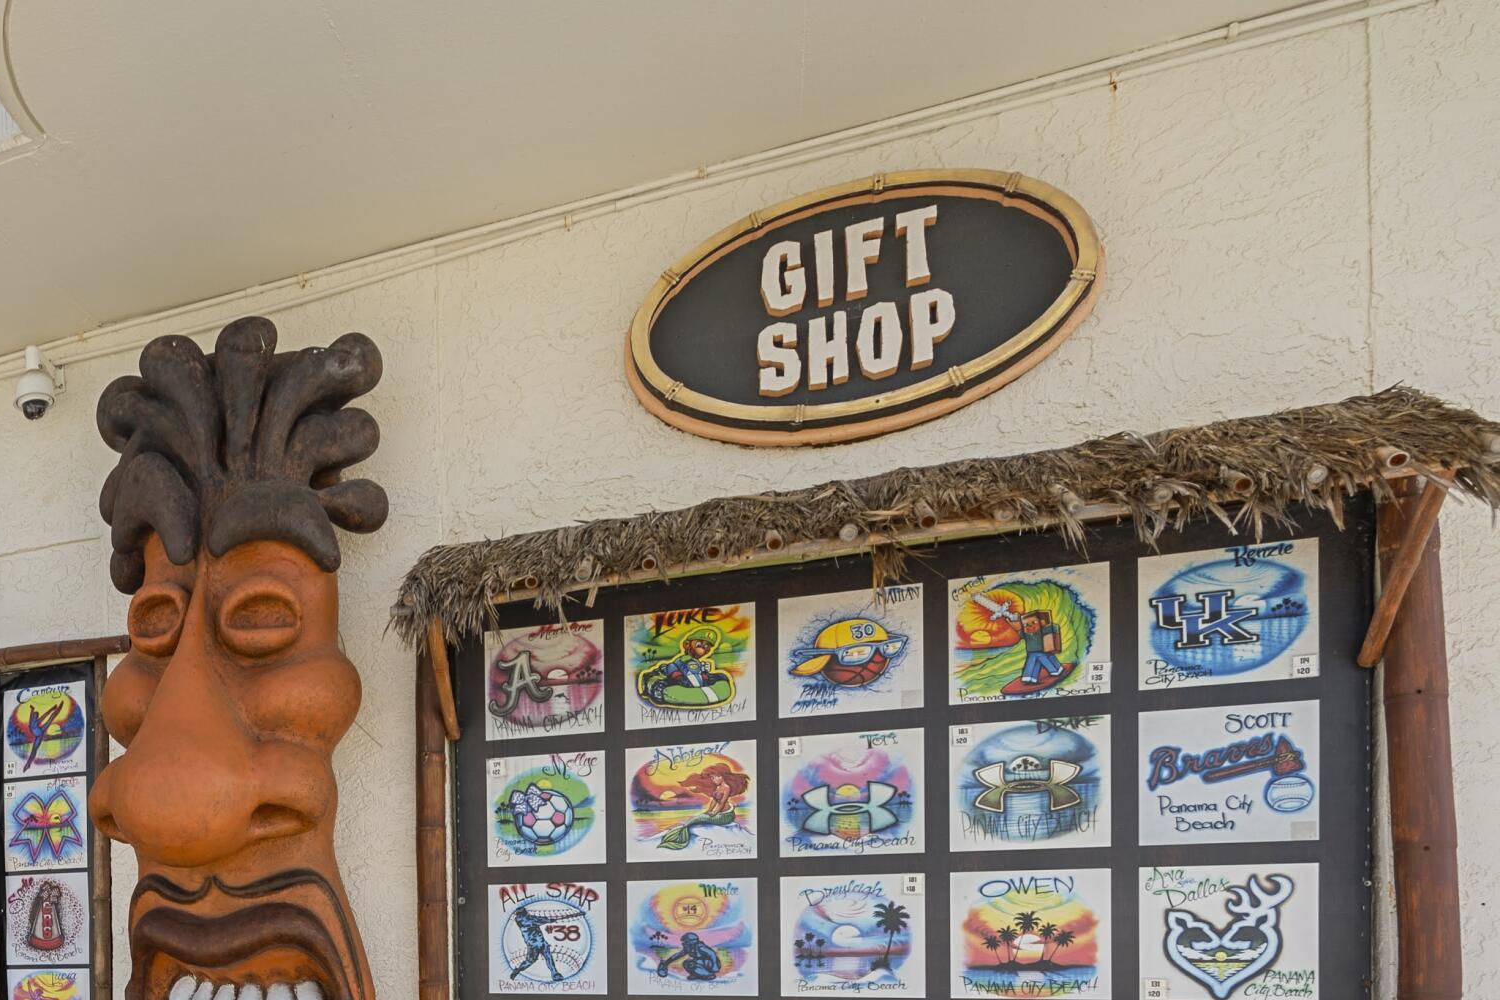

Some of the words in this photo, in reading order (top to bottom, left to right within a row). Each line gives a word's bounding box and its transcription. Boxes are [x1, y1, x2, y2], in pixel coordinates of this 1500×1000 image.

[760, 205, 938, 317] GIFT
[756, 288, 956, 398] SHOP
[851, 623, 875, 640] 30
[640, 704, 681, 725] PANAMA
[711, 698, 746, 720] BEACH
[1224, 711, 1293, 734] SCOTT
[1147, 732, 1275, 791] Braves
[1157, 795, 1218, 815] Panama
[1225, 794, 1254, 814] City
[961, 810, 1011, 843] PANAMA
[1044, 804, 1100, 837] BEACH
[1175, 813, 1236, 832] Beach
[786, 837, 840, 852] Panama
[842, 836, 864, 854] City
[863, 830, 916, 847] Beach
[500, 883, 536, 912] ALL
[546, 882, 599, 911] STAR
[979, 875, 1075, 898] OWEN
[1153, 878, 1230, 908] Dallas
[498, 980, 536, 992] PANAMA
[538, 980, 557, 993] CITY
[561, 980, 596, 992] BEACH
[796, 979, 837, 992] Panama
[840, 981, 861, 993] City
[867, 981, 907, 991] Beach
[959, 976, 1016, 996] PANAMA
[1046, 976, 1098, 995] BEACH
[1263, 970, 1316, 984] PANAMA
